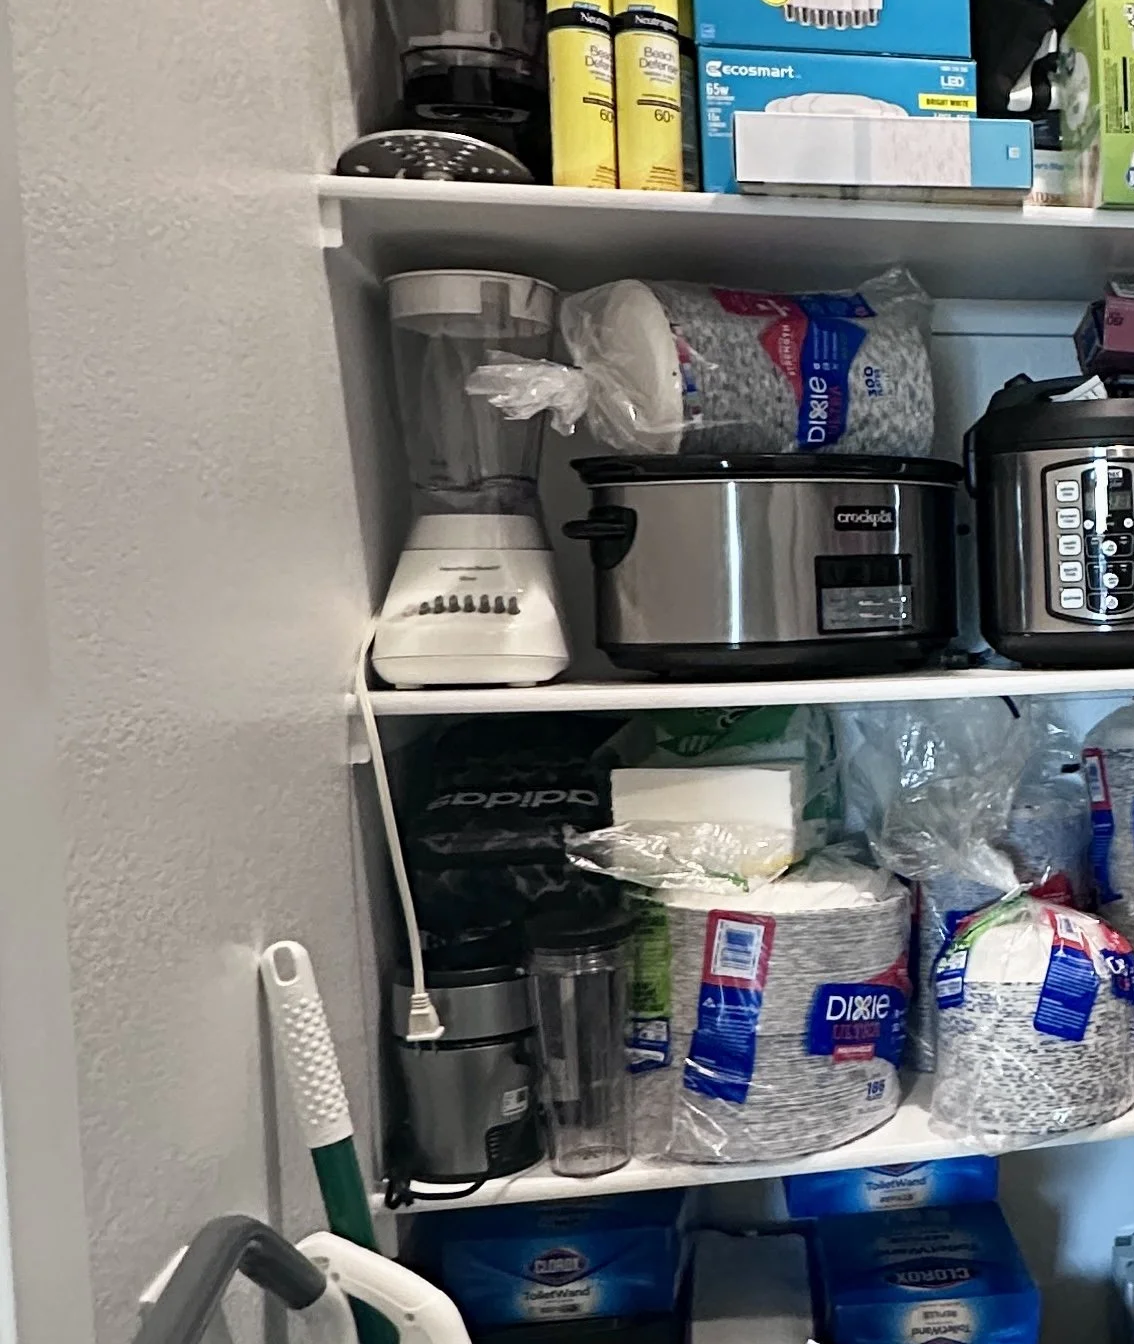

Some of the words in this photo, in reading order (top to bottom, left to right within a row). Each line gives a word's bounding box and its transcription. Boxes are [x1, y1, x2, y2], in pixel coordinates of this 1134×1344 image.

[643, 46, 675, 61] Beach
[722, 63, 795, 80] ecosmart
[705, 82, 730, 97] 65w
[940, 75, 965, 88] LED
[864, 365, 880, 398] 300
[807, 375, 828, 444] DIXIE
[426, 787, 600, 812] adidas
[825, 993, 891, 1021] DIXIE
[865, 1176, 928, 1192] ToiletWand
[533, 1255, 582, 1275] CLOROX
[895, 1266, 970, 1284] CLOROX
[910, 1323, 972, 1338] ToiletWand
